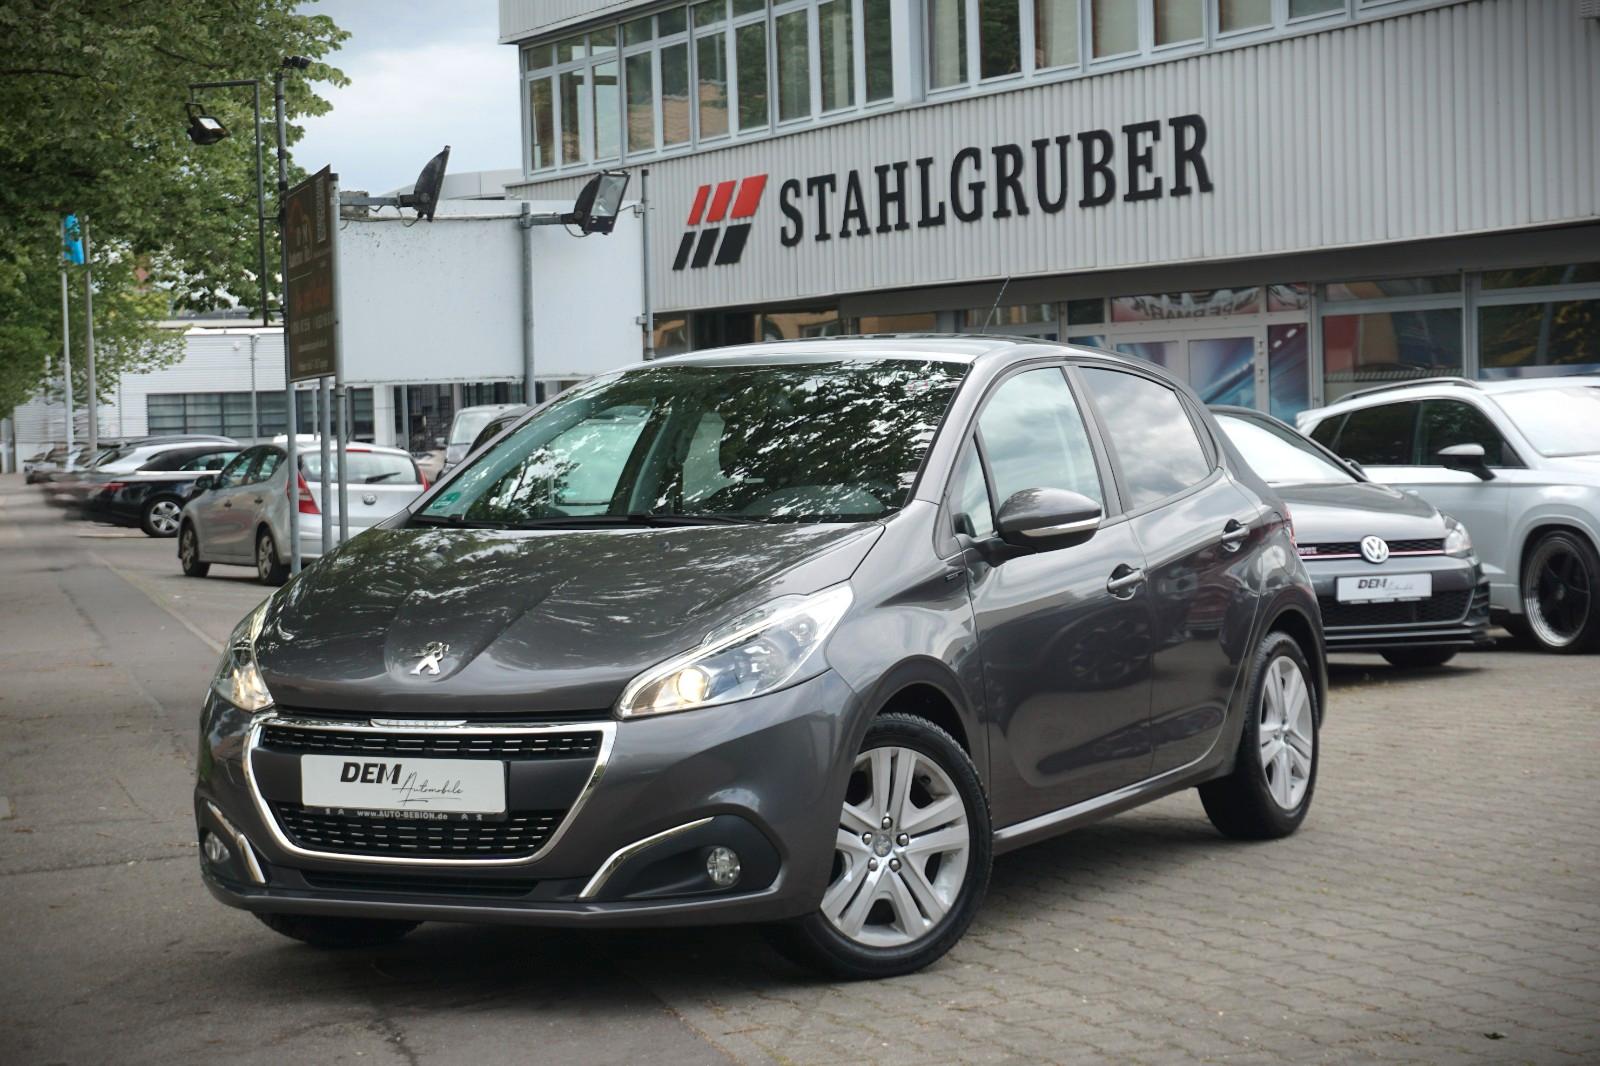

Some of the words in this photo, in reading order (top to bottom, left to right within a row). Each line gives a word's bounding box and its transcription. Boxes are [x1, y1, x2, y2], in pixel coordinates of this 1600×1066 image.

[780, 113, 1214, 248] STAHLGRUBER
[340, 762, 402, 785] DEM
[393, 771, 463, 806] Automobile
